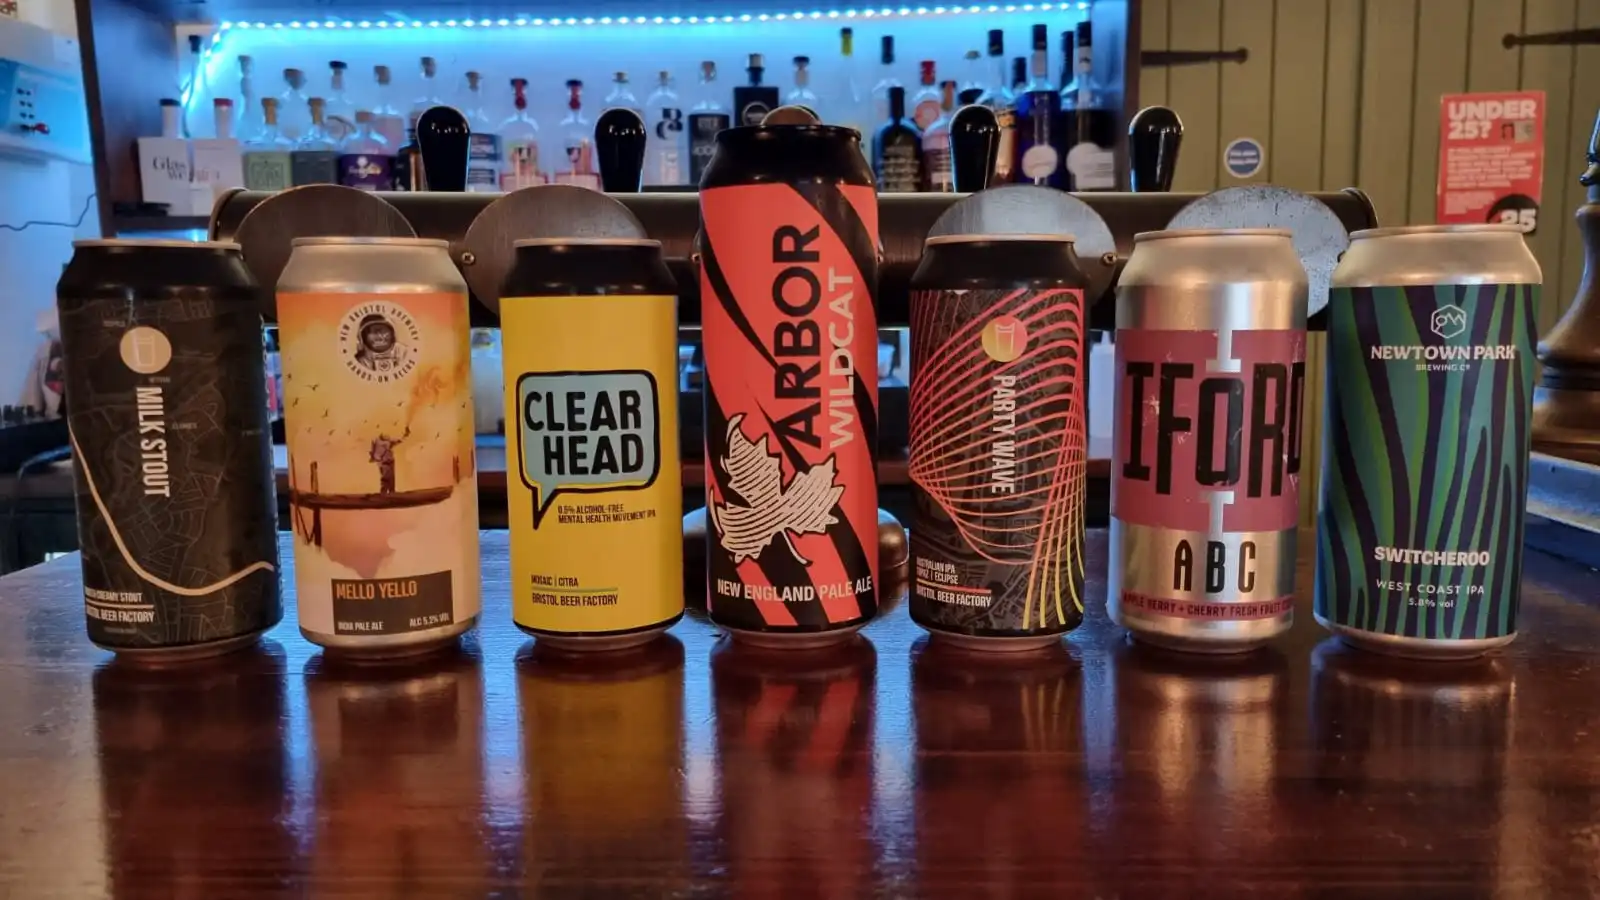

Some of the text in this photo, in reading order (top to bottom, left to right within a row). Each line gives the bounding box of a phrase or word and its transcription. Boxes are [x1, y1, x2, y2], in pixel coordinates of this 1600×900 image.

[1447, 99, 1537, 121] UNDER
[1447, 120, 1493, 139] 25?
[1501, 208, 1536, 232] 25
[340, 304, 419, 341] NEW BRISTOL BREWERY
[772, 224, 822, 449] ARBOR
[828, 267, 855, 449] WILDCAT
[1370, 344, 1516, 360] NEWTOWN PARK
[136, 387, 165, 434] MILK
[524, 390, 641, 432] CLEAR
[991, 375, 1017, 494] PARTY WAVE
[543, 433, 644, 475] HEAD
[140, 438, 170, 497] STOUT
[558, 509, 656, 524] MENTAL HEALTH MOVEMENT IPA
[575, 503, 625, 514] ALCOHOL-FREE
[1374, 546, 1490, 566] SWITCHEROO
[944, 563, 956, 574] IPA
[531, 574, 553, 586] MOSAIC
[558, 577, 579, 587] CITRA
[934, 571, 959, 585] ECLIPSE
[1376, 579, 1485, 595] WEST COAST IPA
[119, 592, 143, 603] STOUT
[336, 580, 418, 600] MELLO YELLO
[717, 575, 872, 602] NEW ENGLAND PALE ALE
[532, 593, 618, 606] BRISTOL BEER FACTORY
[937, 590, 955, 604] BEER
[956, 593, 992, 608] FACTORY
[1408, 597, 1454, 608] 5.8% vol
[100, 608, 117, 622] BEER
[118, 610, 155, 623] FACTORY
[1187, 604, 1226, 616] CHERRY
[1229, 604, 1258, 616] FRESH
[1259, 603, 1280, 615] FRUIT
[338, 621, 384, 631] INDIA PALE ALE
[409, 617, 422, 628] ALC
